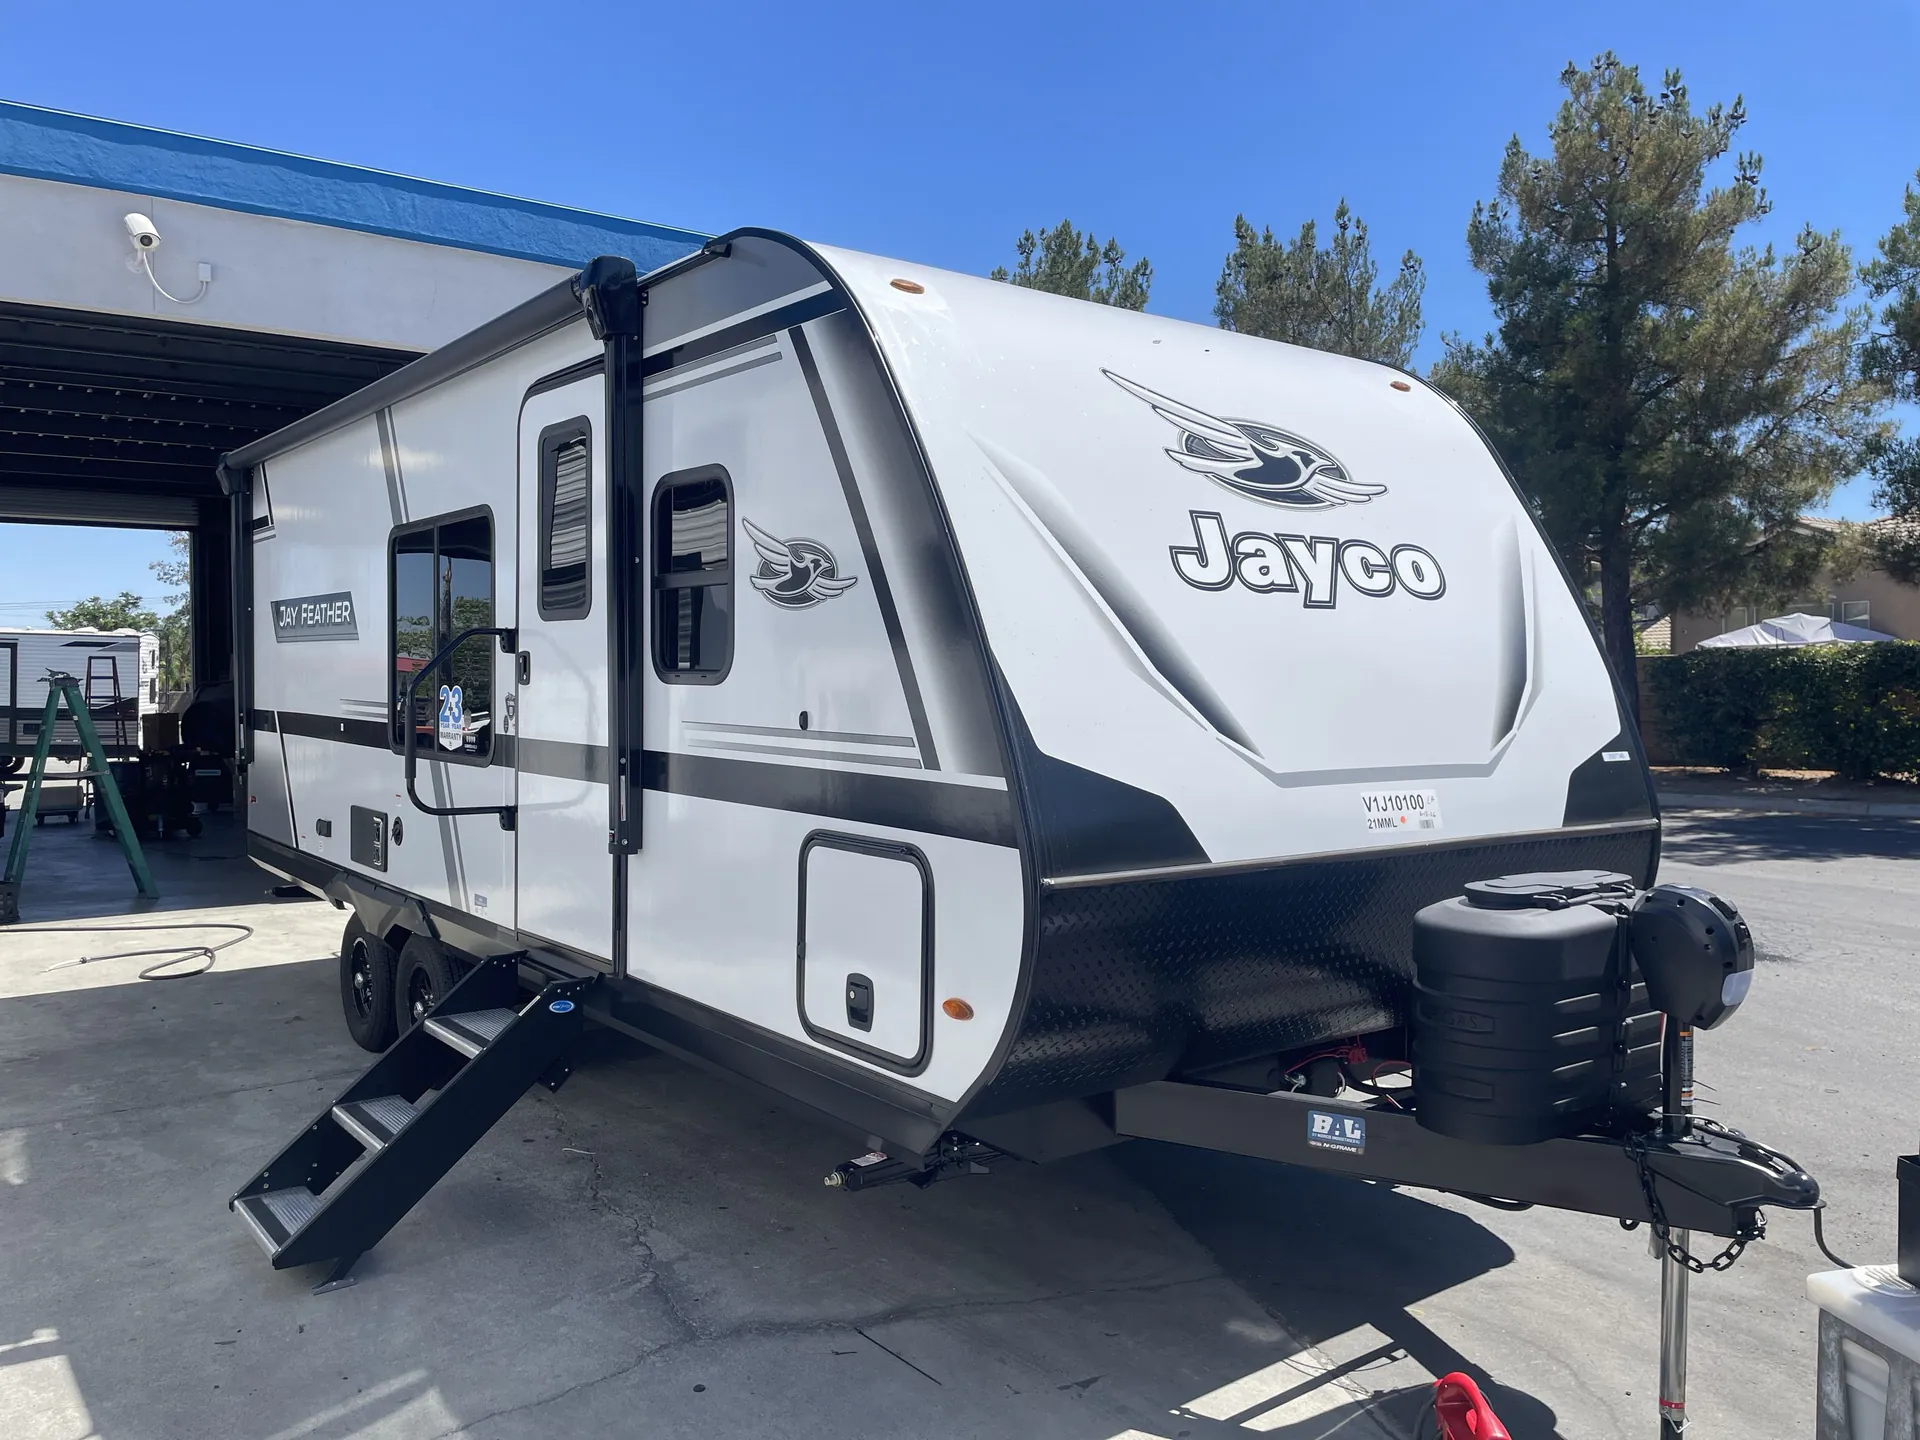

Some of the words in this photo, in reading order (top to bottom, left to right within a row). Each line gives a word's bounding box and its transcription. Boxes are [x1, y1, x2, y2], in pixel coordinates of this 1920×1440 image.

[1168, 509, 1447, 609] Jayco
[279, 605, 299, 627] JAY
[301, 601, 351, 625] FEATHER
[1362, 794, 1424, 812] V1J10100
[1367, 817, 1398, 829] 21MML
[1312, 1114, 1361, 1139] BAL
